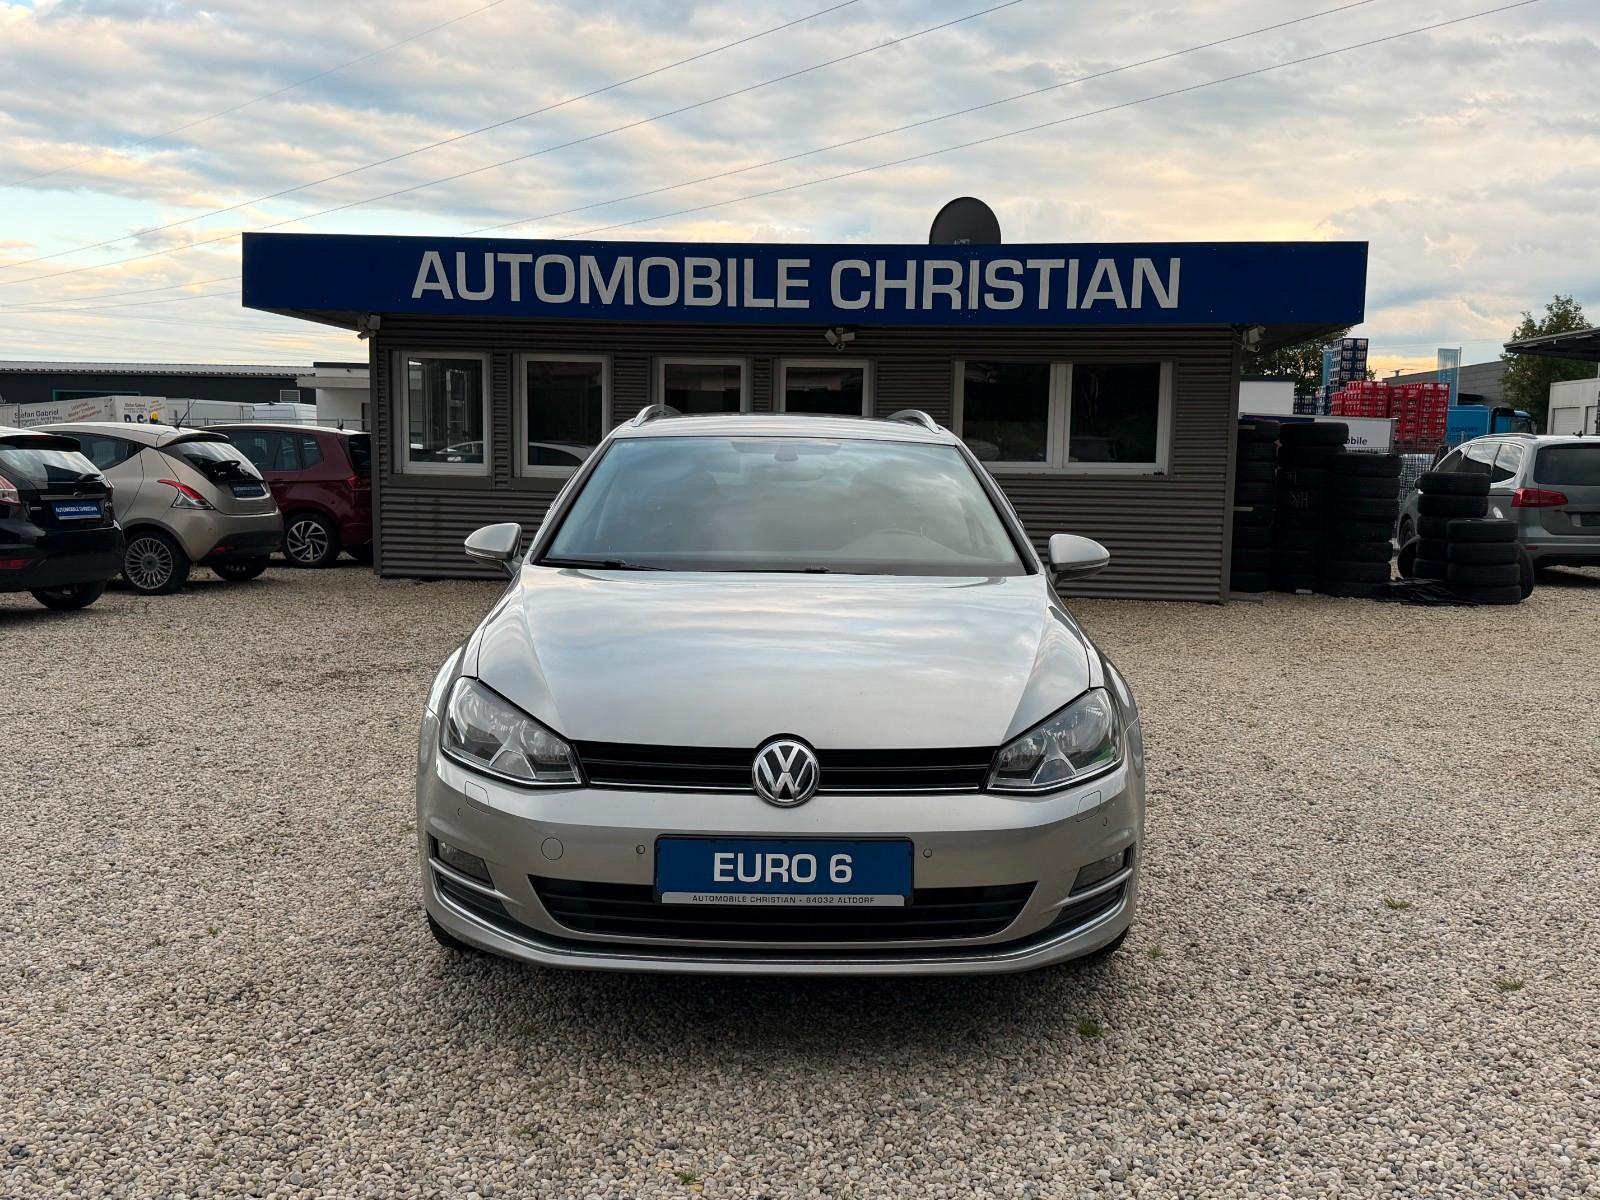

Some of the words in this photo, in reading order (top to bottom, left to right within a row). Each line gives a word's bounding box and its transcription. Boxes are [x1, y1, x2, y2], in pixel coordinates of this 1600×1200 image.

[411, 251, 811, 309] AUTOMOBILE
[830, 257, 1181, 310] CHRISTIAN
[35, 408, 59, 418] Gabriel
[757, 741, 815, 801] VW
[713, 852, 818, 883] EURO
[829, 853, 853, 883] 6
[692, 895, 747, 903] AUTOMOBILE
[750, 896, 796, 904] CHRISTIAN
[806, 896, 834, 904] 84032
